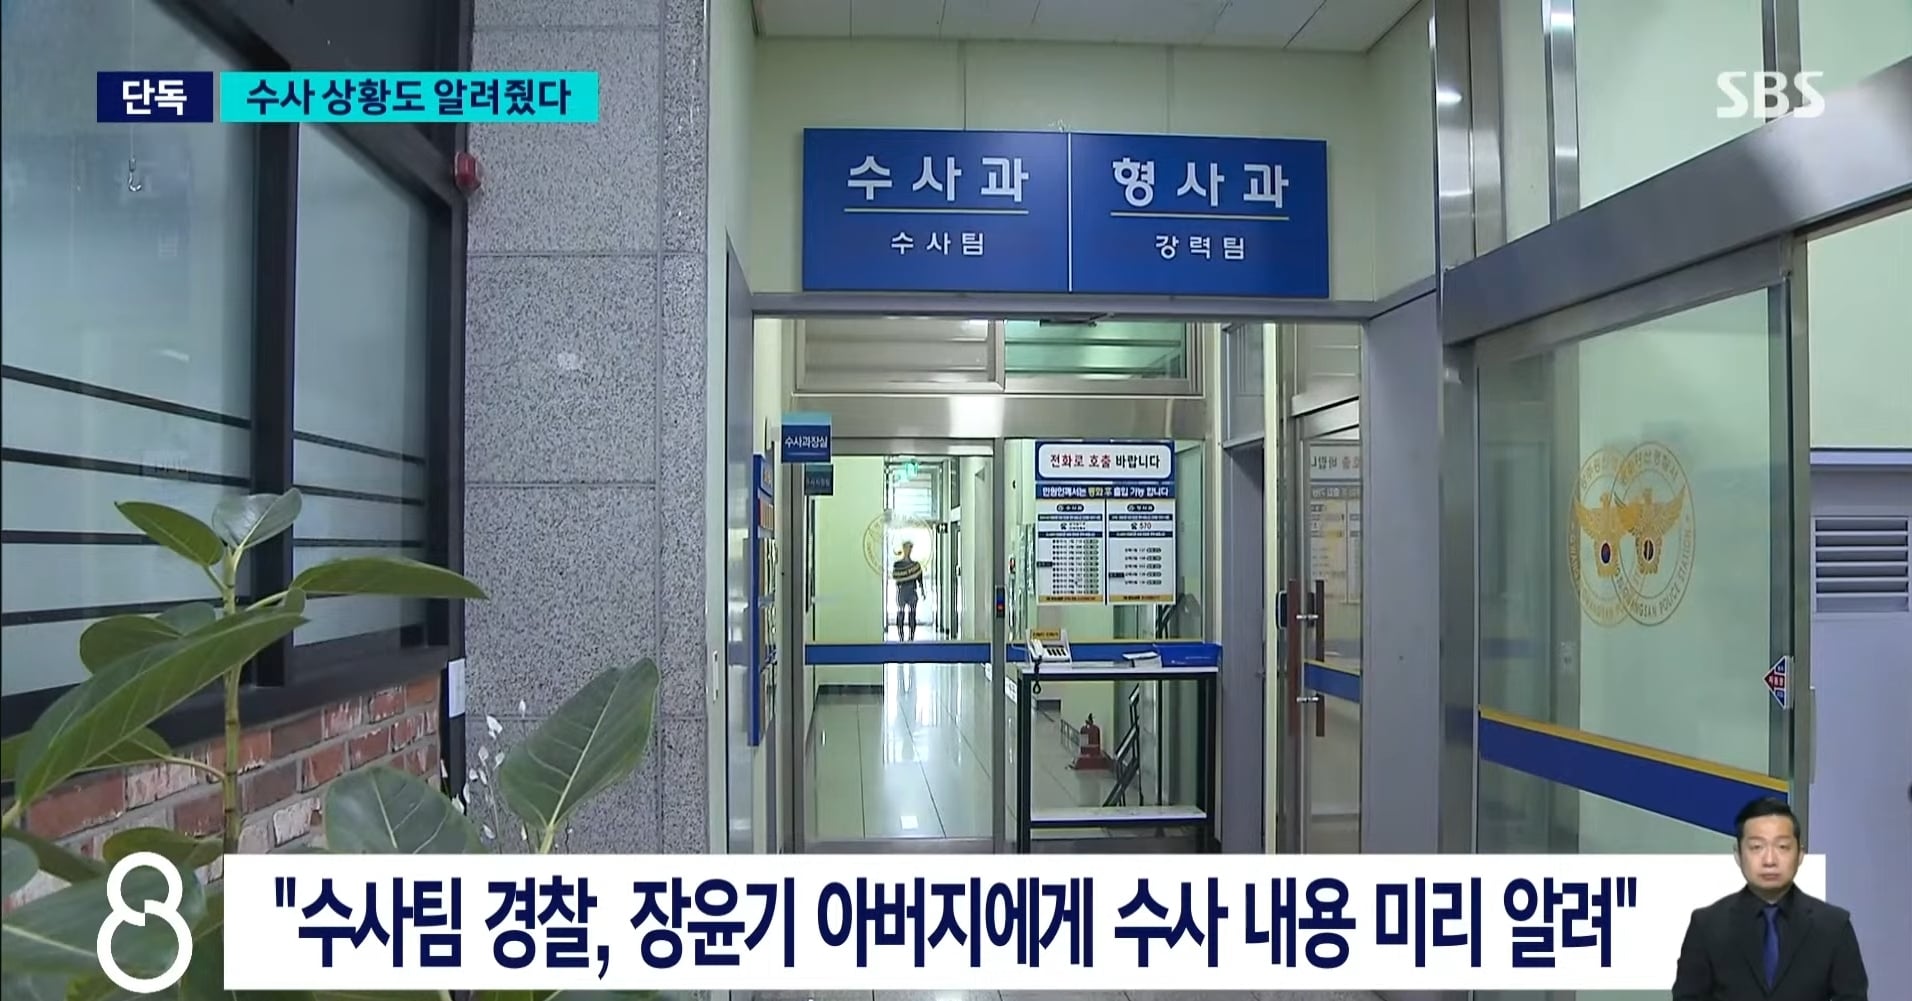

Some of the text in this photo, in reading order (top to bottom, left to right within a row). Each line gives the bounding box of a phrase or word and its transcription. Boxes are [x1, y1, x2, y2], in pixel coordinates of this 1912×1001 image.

[847, 155, 1030, 202] 수사과
[1112, 157, 1289, 209] 형사과
[891, 232, 984, 256] 수사팀
[1155, 235, 1244, 260] 강력팀
[784, 435, 828, 449] 수사과장실
[1050, 454, 1160, 469] 전화로 호출 바랍니다
[1042, 486, 1087, 498] 민원인께서는
[1113, 486, 1129, 498] 출입
[1139, 522, 1152, 530] 570
[1658, 584, 1682, 615] POLICE
